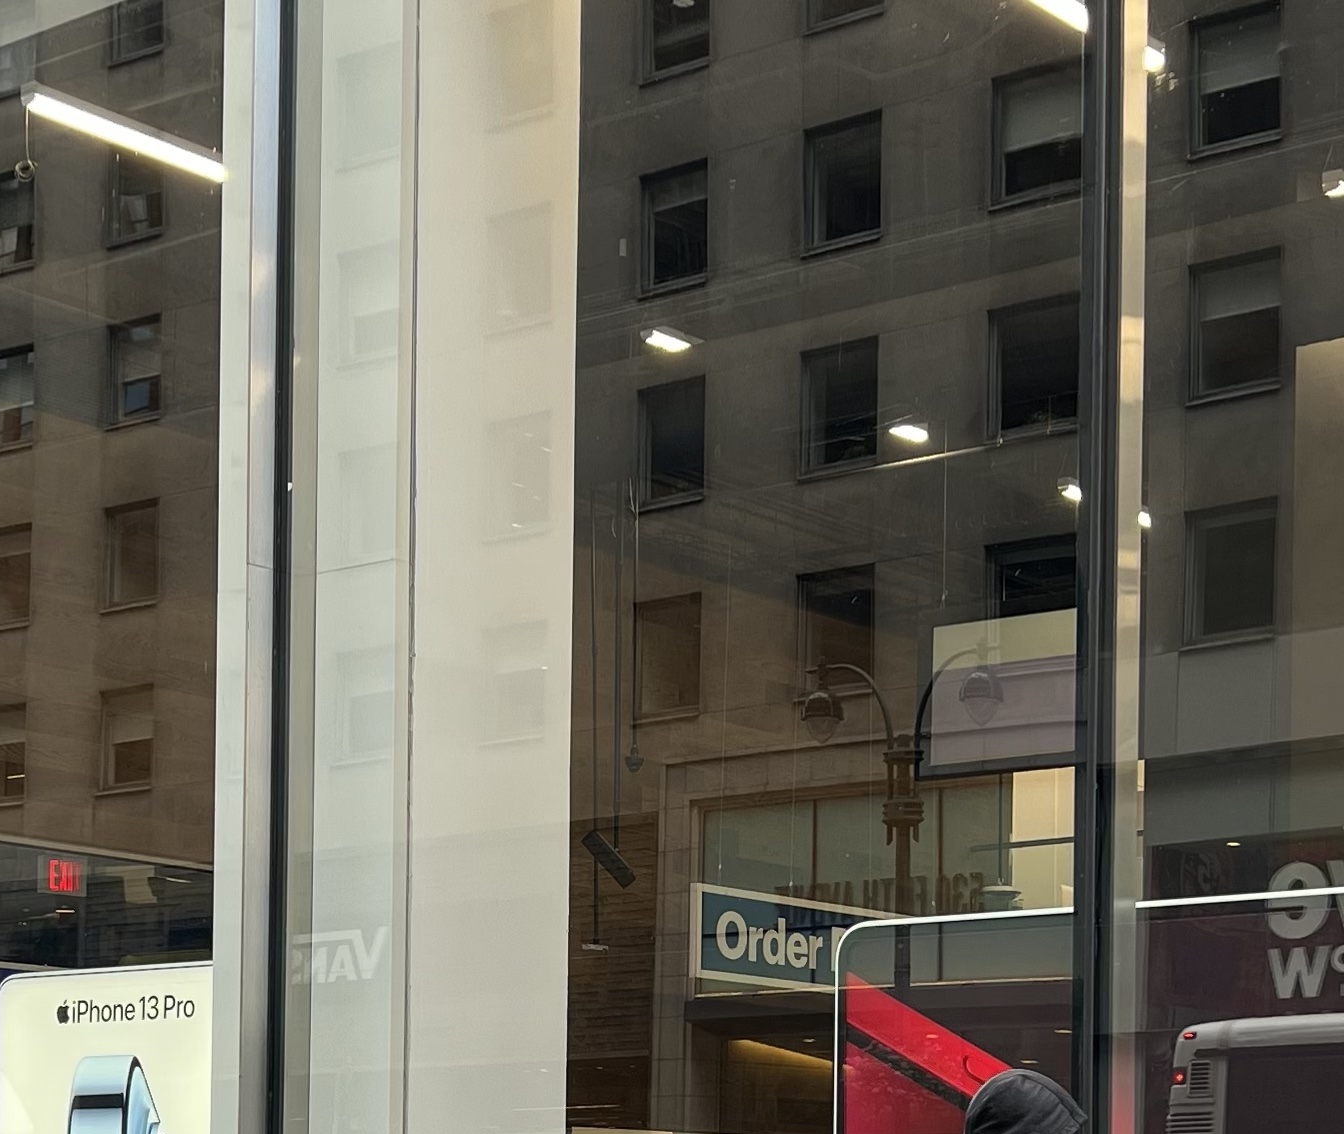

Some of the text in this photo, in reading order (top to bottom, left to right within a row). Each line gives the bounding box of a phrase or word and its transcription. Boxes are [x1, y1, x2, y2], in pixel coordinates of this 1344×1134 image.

[49, 859, 81, 893] EXIT
[716, 910, 824, 970] Order
[72, 995, 195, 1024] iPhone 13 Pro
